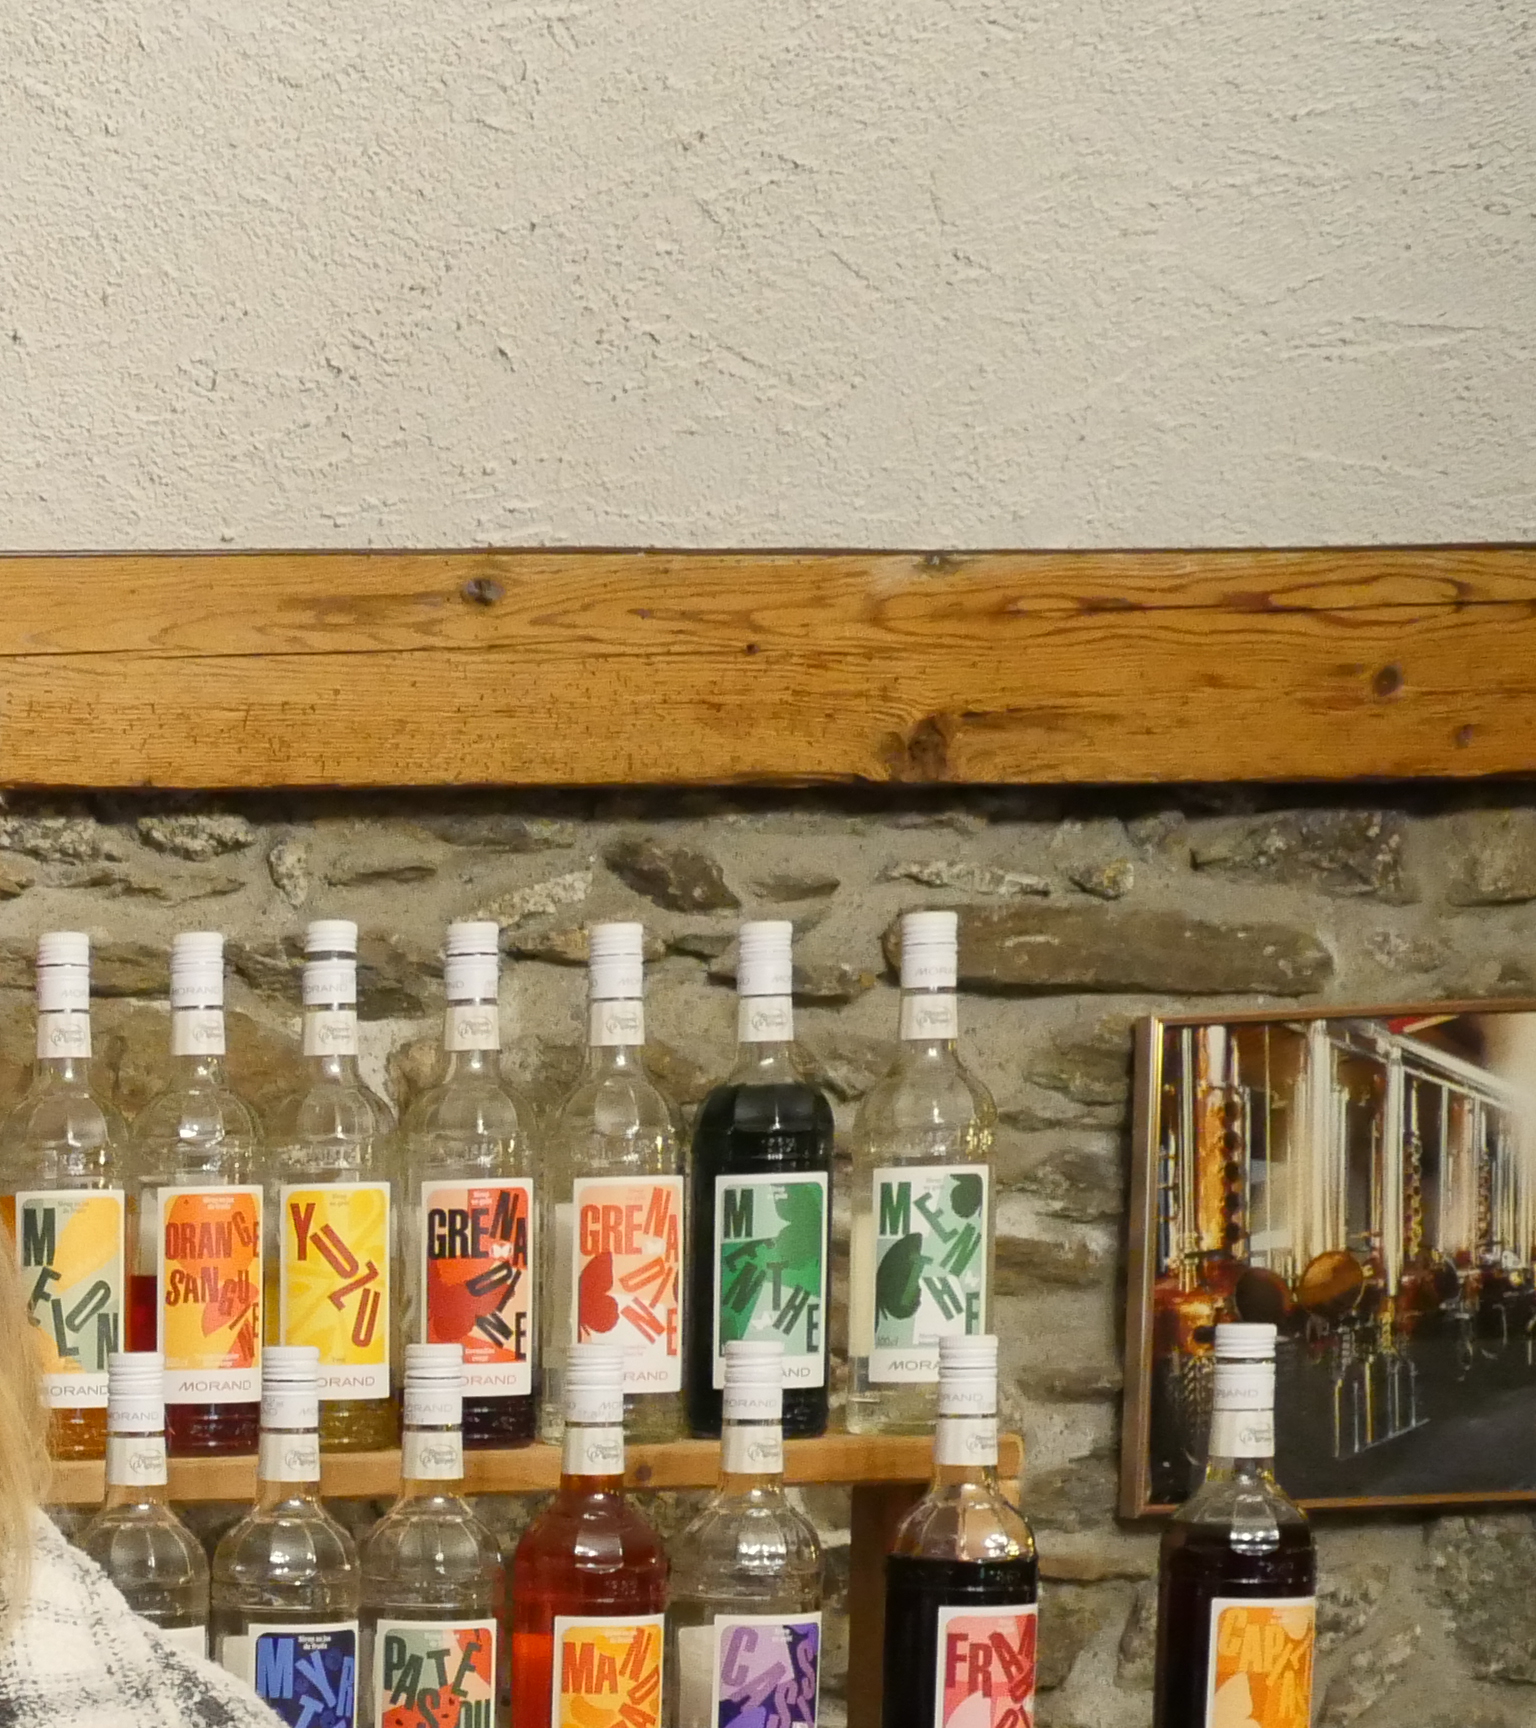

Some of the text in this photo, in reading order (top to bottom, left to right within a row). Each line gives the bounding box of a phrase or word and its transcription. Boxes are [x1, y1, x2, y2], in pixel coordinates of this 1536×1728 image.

[290, 1203, 381, 1347] YUZU
[888, 1360, 940, 1371] MORA
[315, 1376, 375, 1388] ORAND
[460, 1374, 517, 1387] ORAND
[623, 1370, 669, 1382] RAND
[49, 1385, 109, 1397] ORAND
[178, 1380, 253, 1392] MORAND
